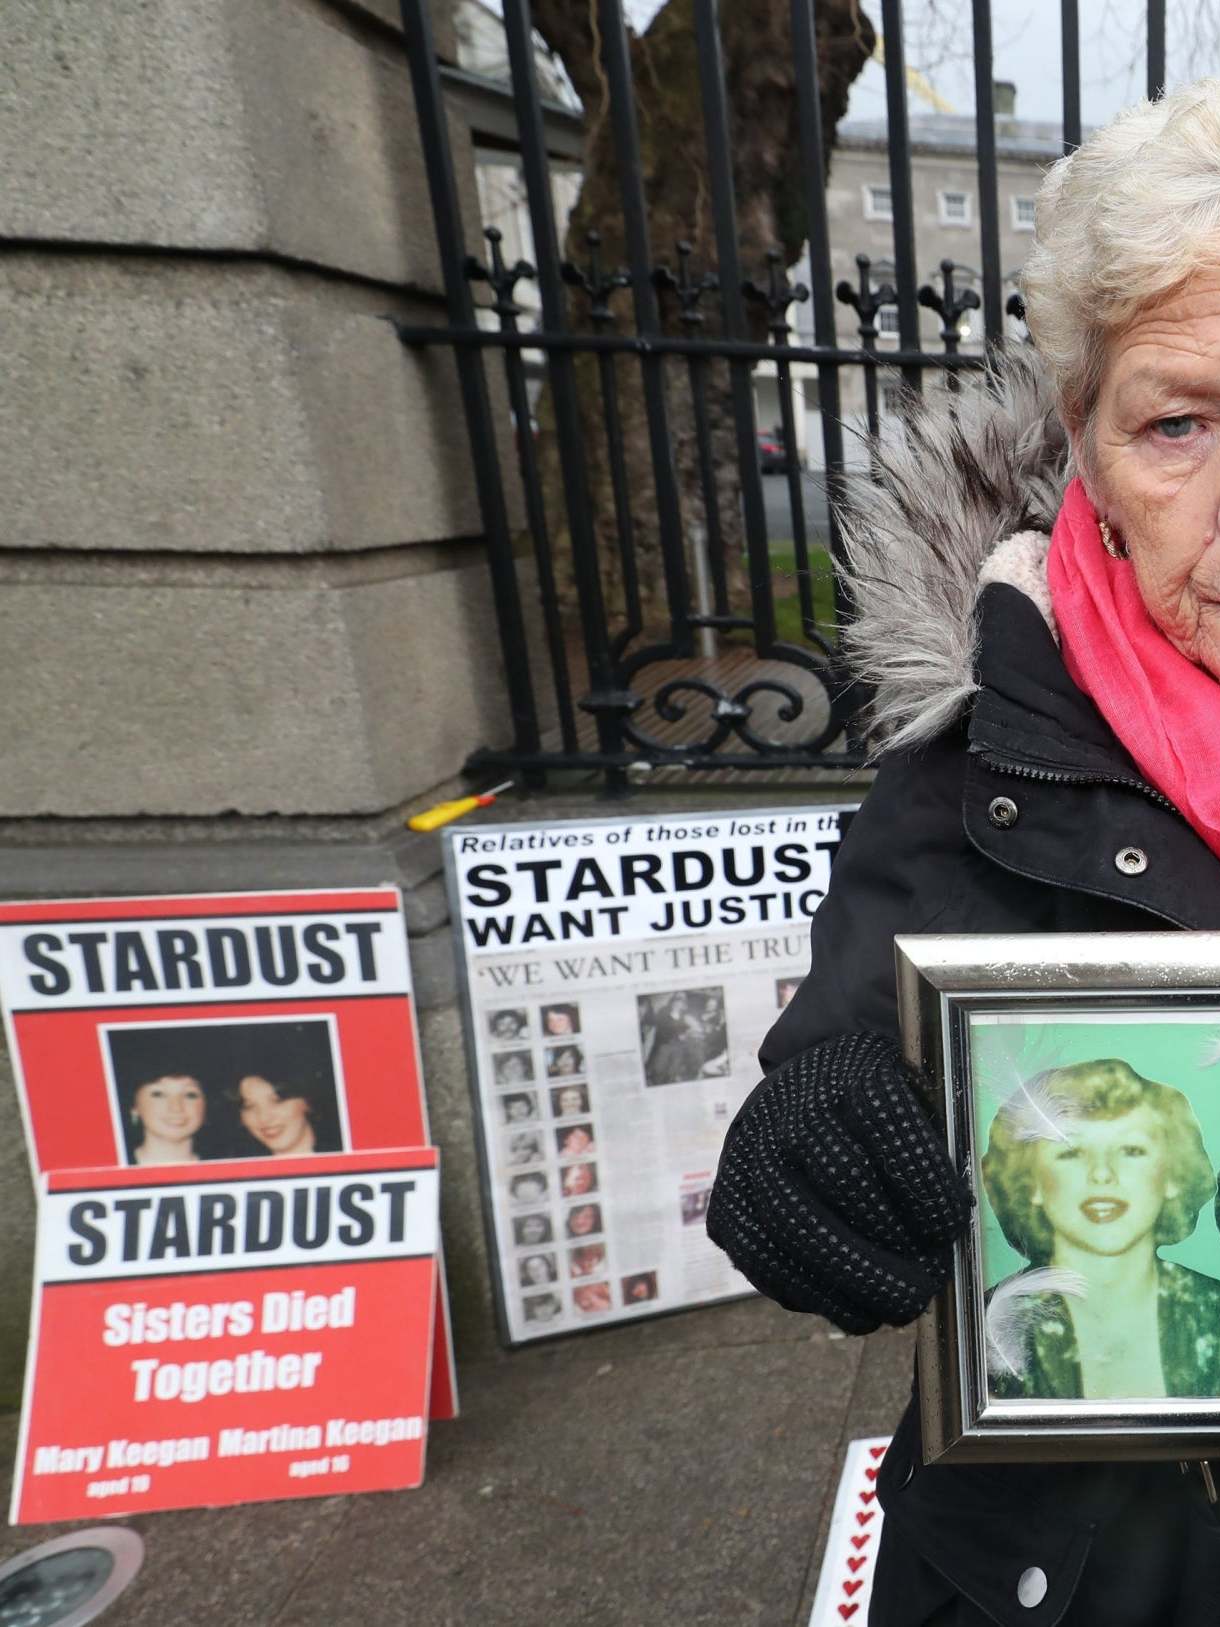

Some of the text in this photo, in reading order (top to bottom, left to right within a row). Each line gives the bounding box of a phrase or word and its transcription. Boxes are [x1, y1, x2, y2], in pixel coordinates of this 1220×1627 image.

[461, 815, 841, 854] Relatives of those lost in th
[466, 841, 841, 909] STARDUST
[467, 889, 825, 947] WANT JUSTIC
[23, 922, 382, 996] STARDUST
[554, 950, 657, 979] WANT
[665, 941, 734, 969] THE
[742, 933, 809, 961] TRU
[68, 1180, 416, 1267] STARDUST
[103, 1287, 356, 1347] Sisters Died
[131, 1350, 322, 1403] Together
[33, 1436, 211, 1476] Mary Keegan
[217, 1415, 423, 1457] Martina Keegan
